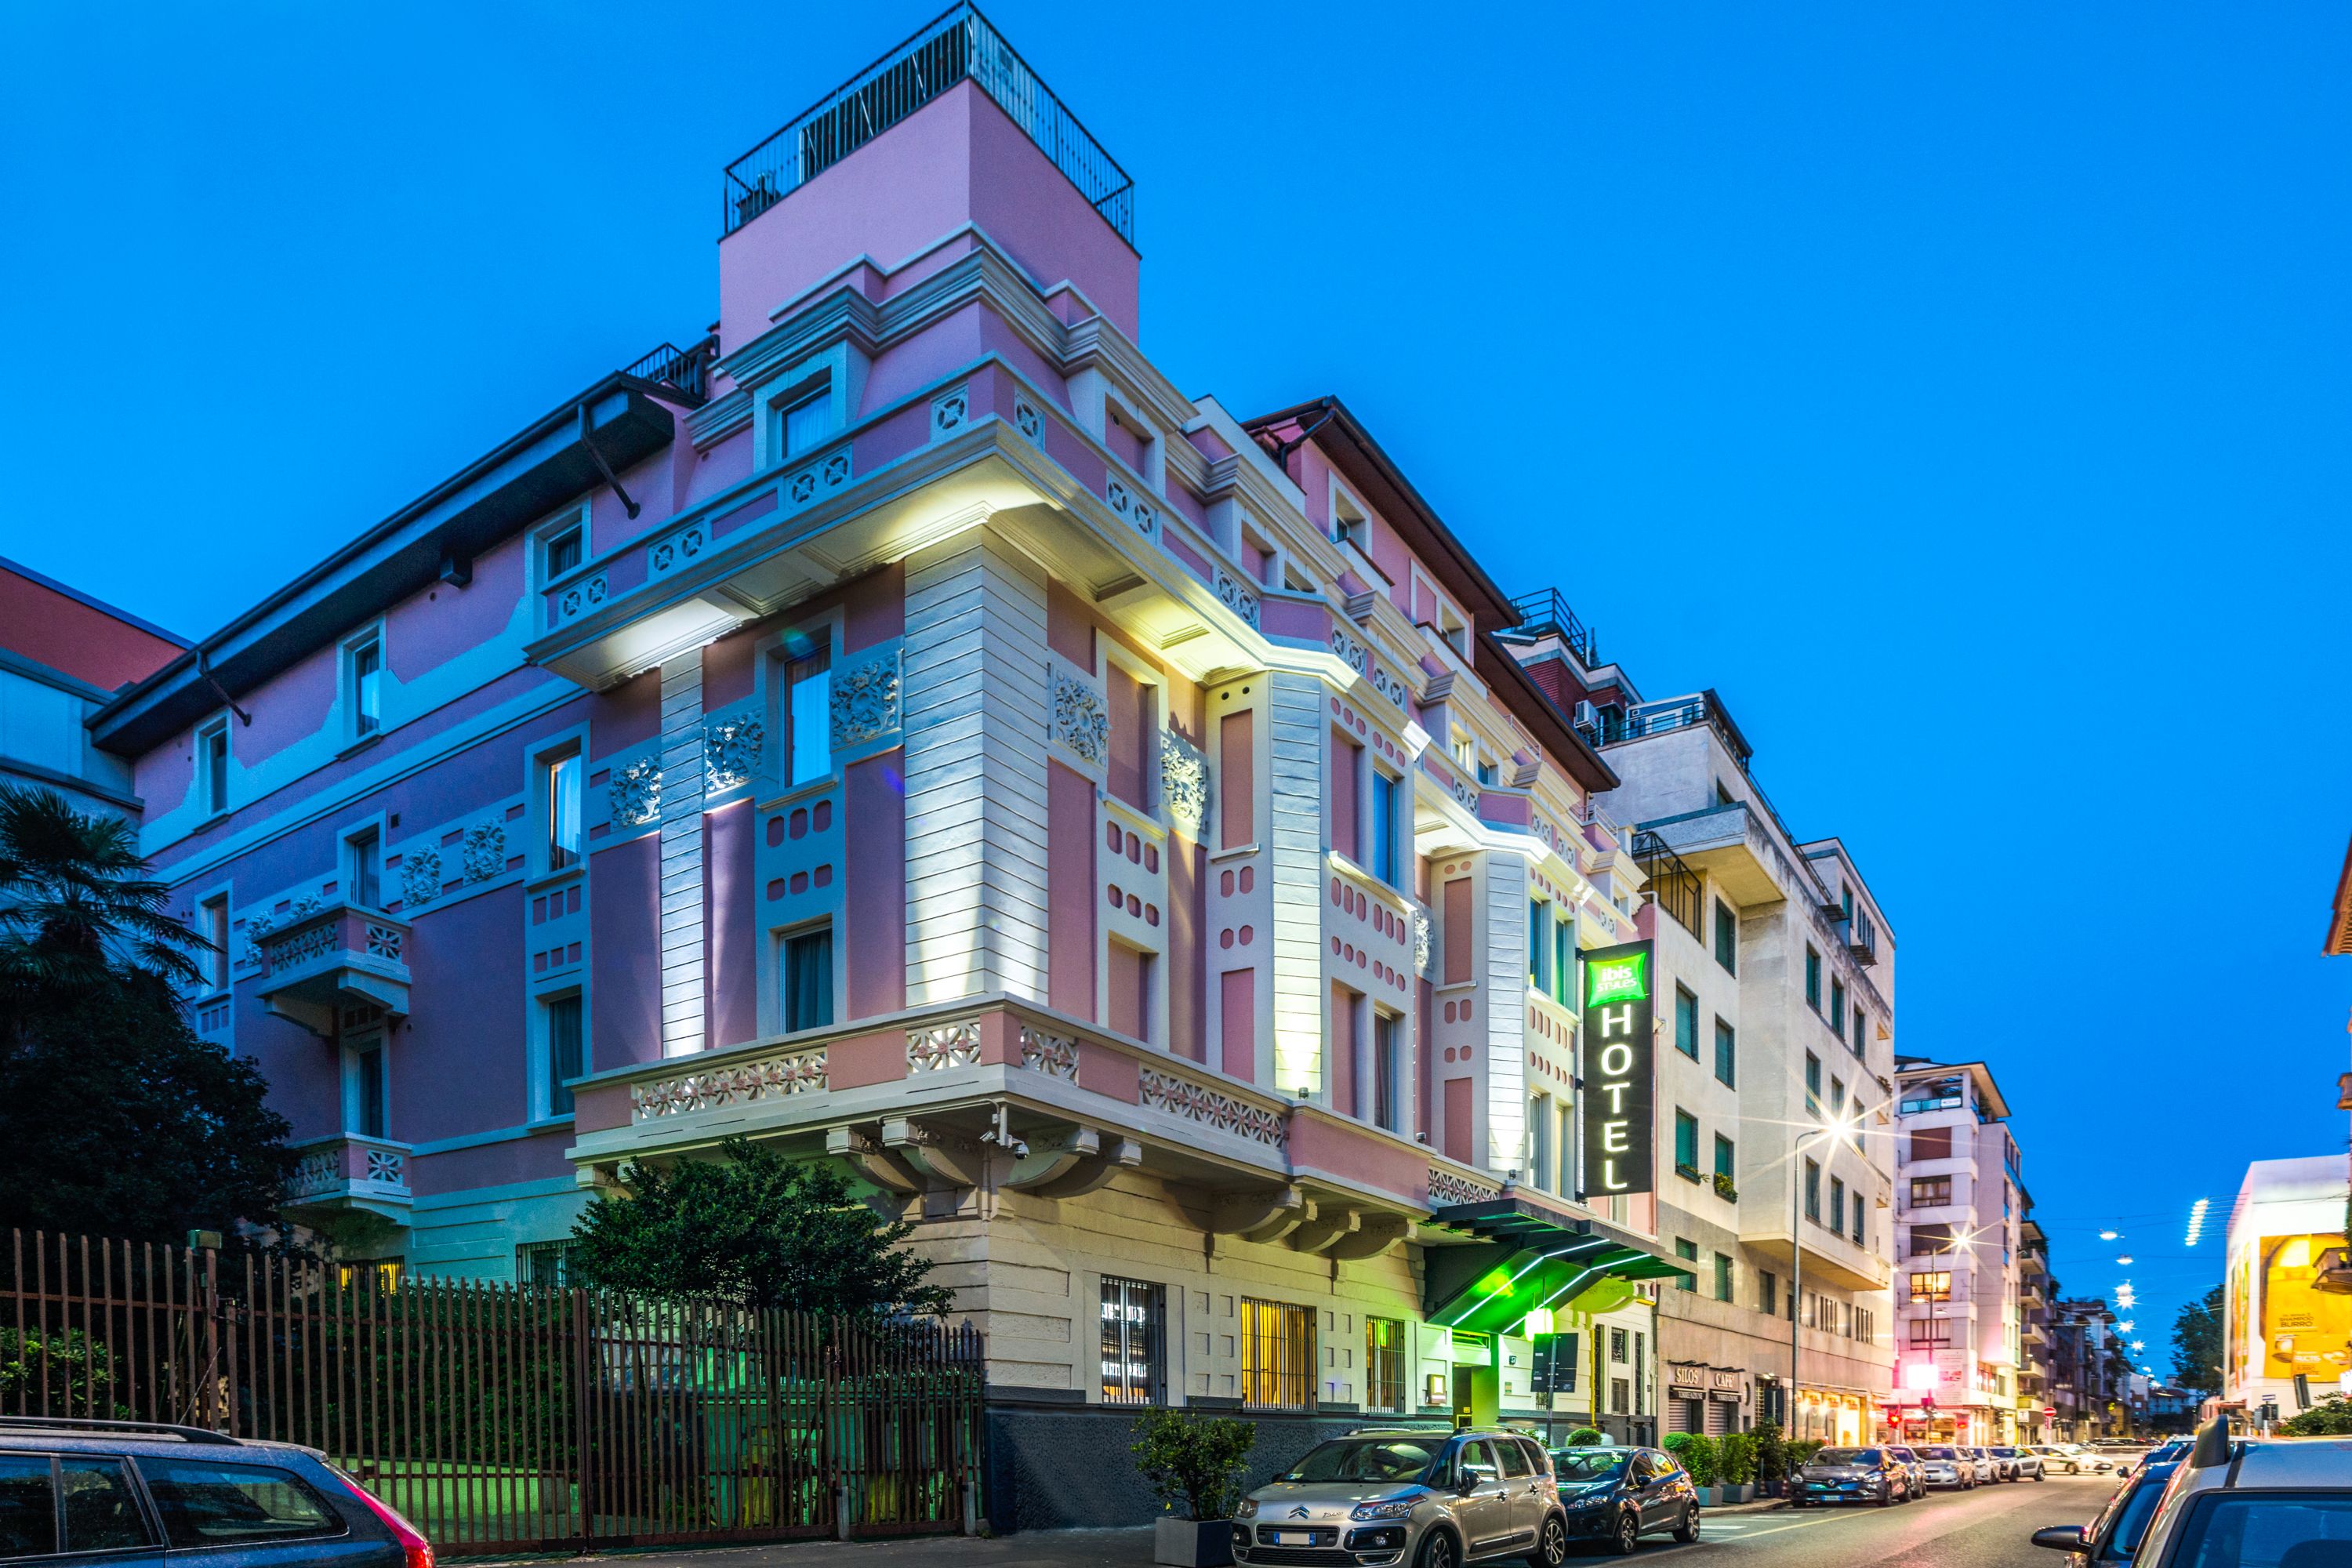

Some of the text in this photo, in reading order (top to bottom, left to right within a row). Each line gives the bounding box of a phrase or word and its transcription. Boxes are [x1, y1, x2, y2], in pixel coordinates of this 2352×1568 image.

[1602, 966, 1632, 982] ibis
[1601, 1004, 1632, 1189] HOTEL
[1675, 1368, 1699, 1385] SILOS
